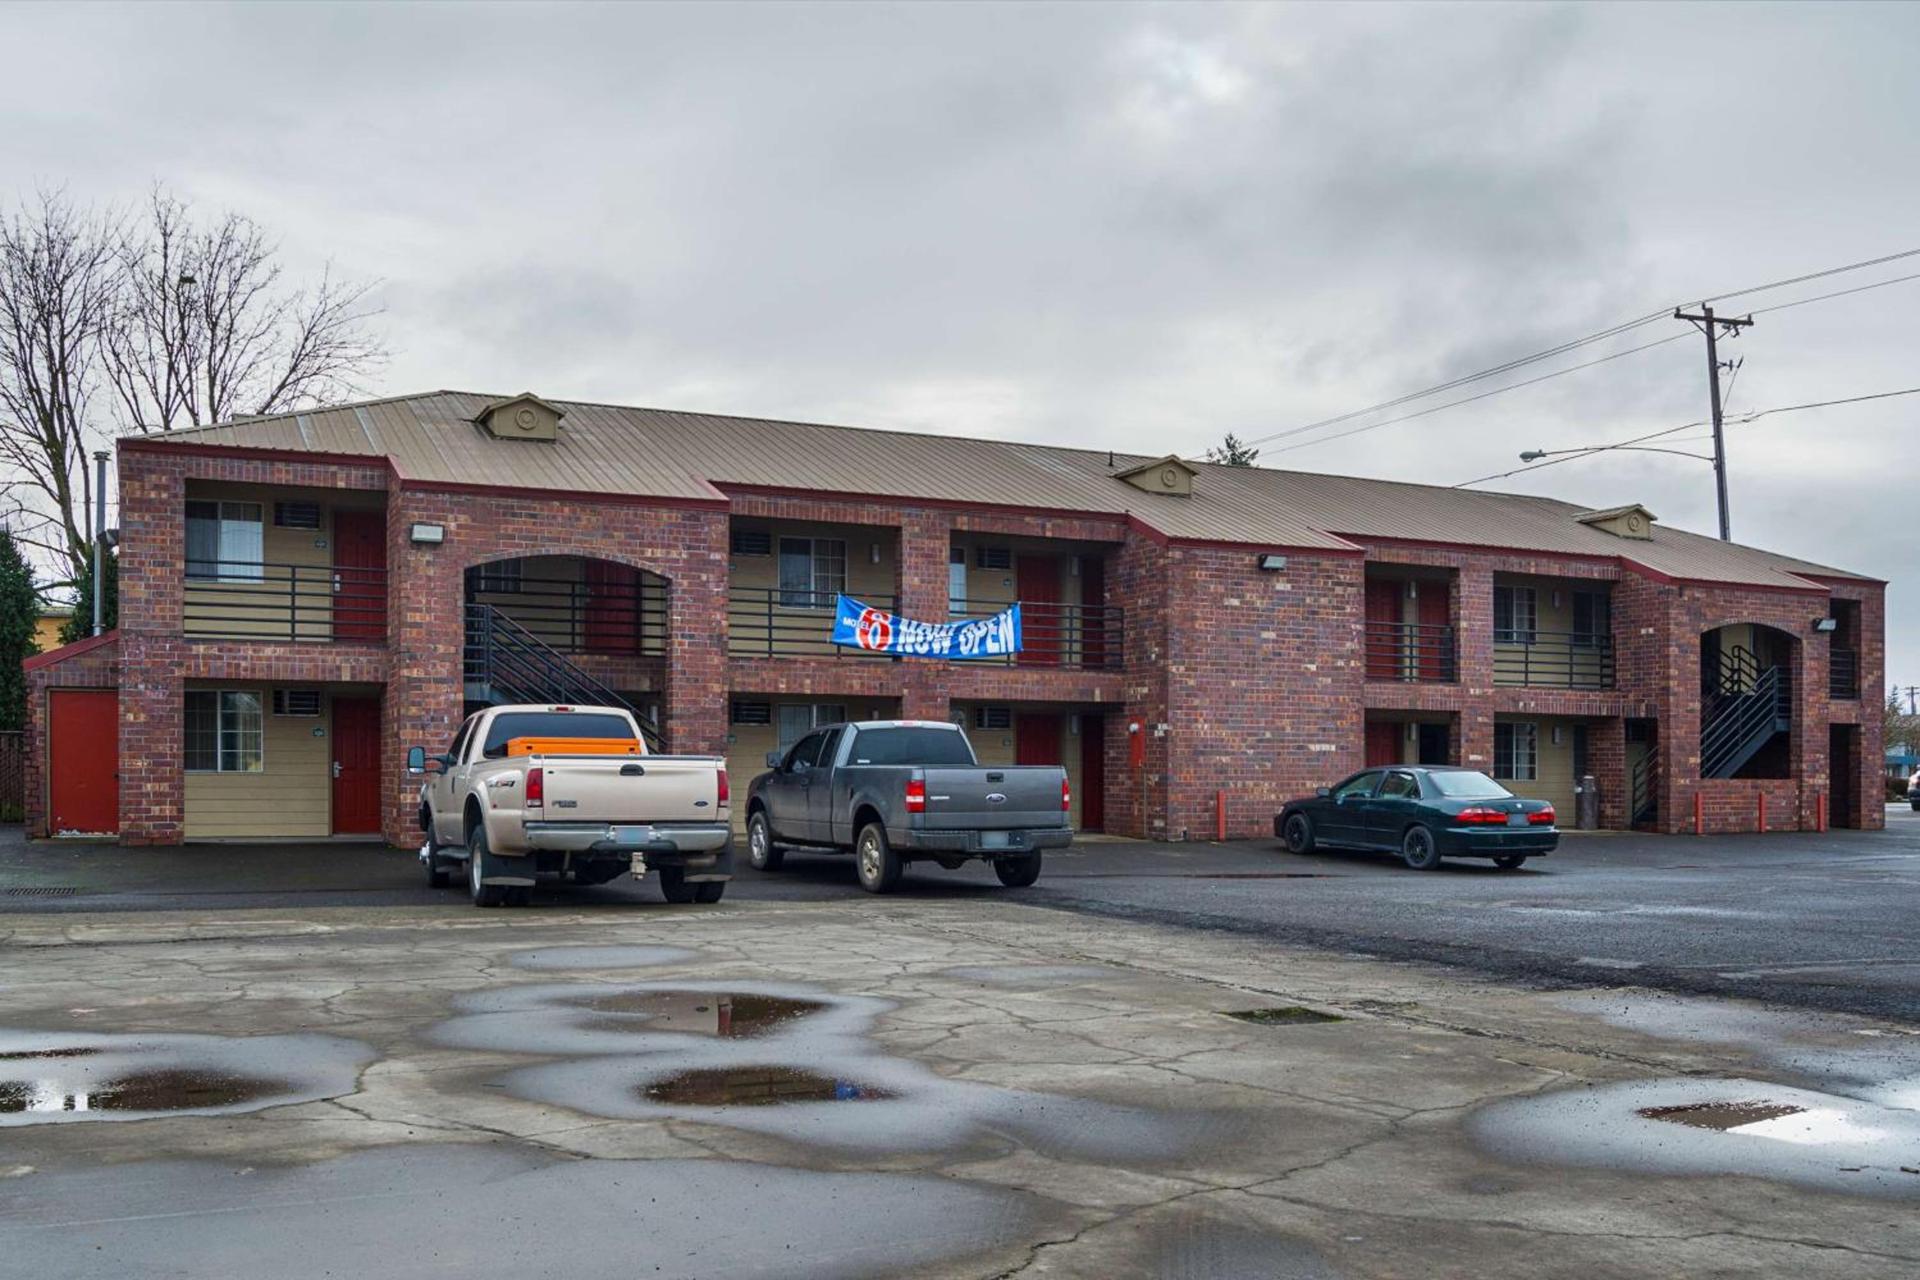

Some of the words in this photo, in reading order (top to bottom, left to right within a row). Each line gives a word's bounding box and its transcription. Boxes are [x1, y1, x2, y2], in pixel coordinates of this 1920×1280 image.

[857, 607, 892, 650] 6
[896, 618, 958, 654] NOW
[959, 609, 1015, 655] OPEN
